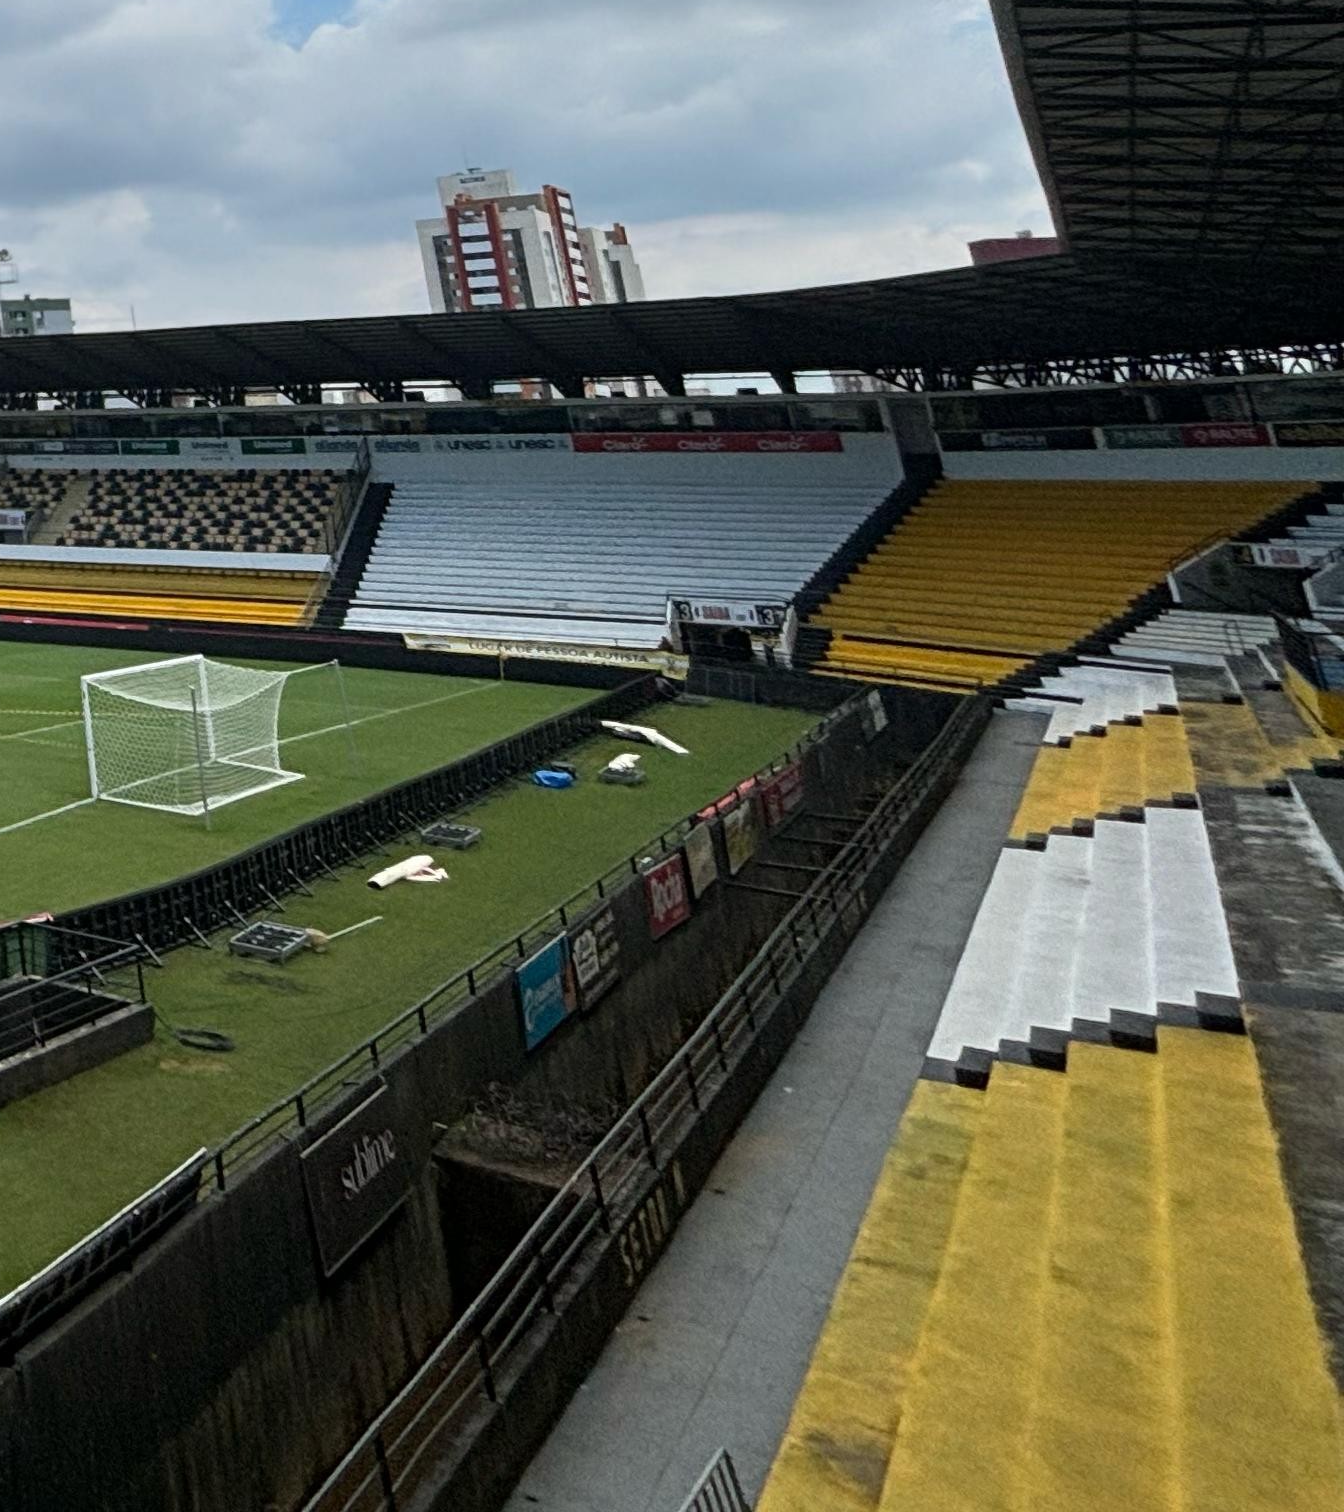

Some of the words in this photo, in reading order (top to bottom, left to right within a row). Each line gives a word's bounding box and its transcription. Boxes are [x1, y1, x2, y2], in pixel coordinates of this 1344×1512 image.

[603, 439, 640, 450] Claro
[677, 439, 717, 450] Claro
[757, 439, 800, 450] Claro
